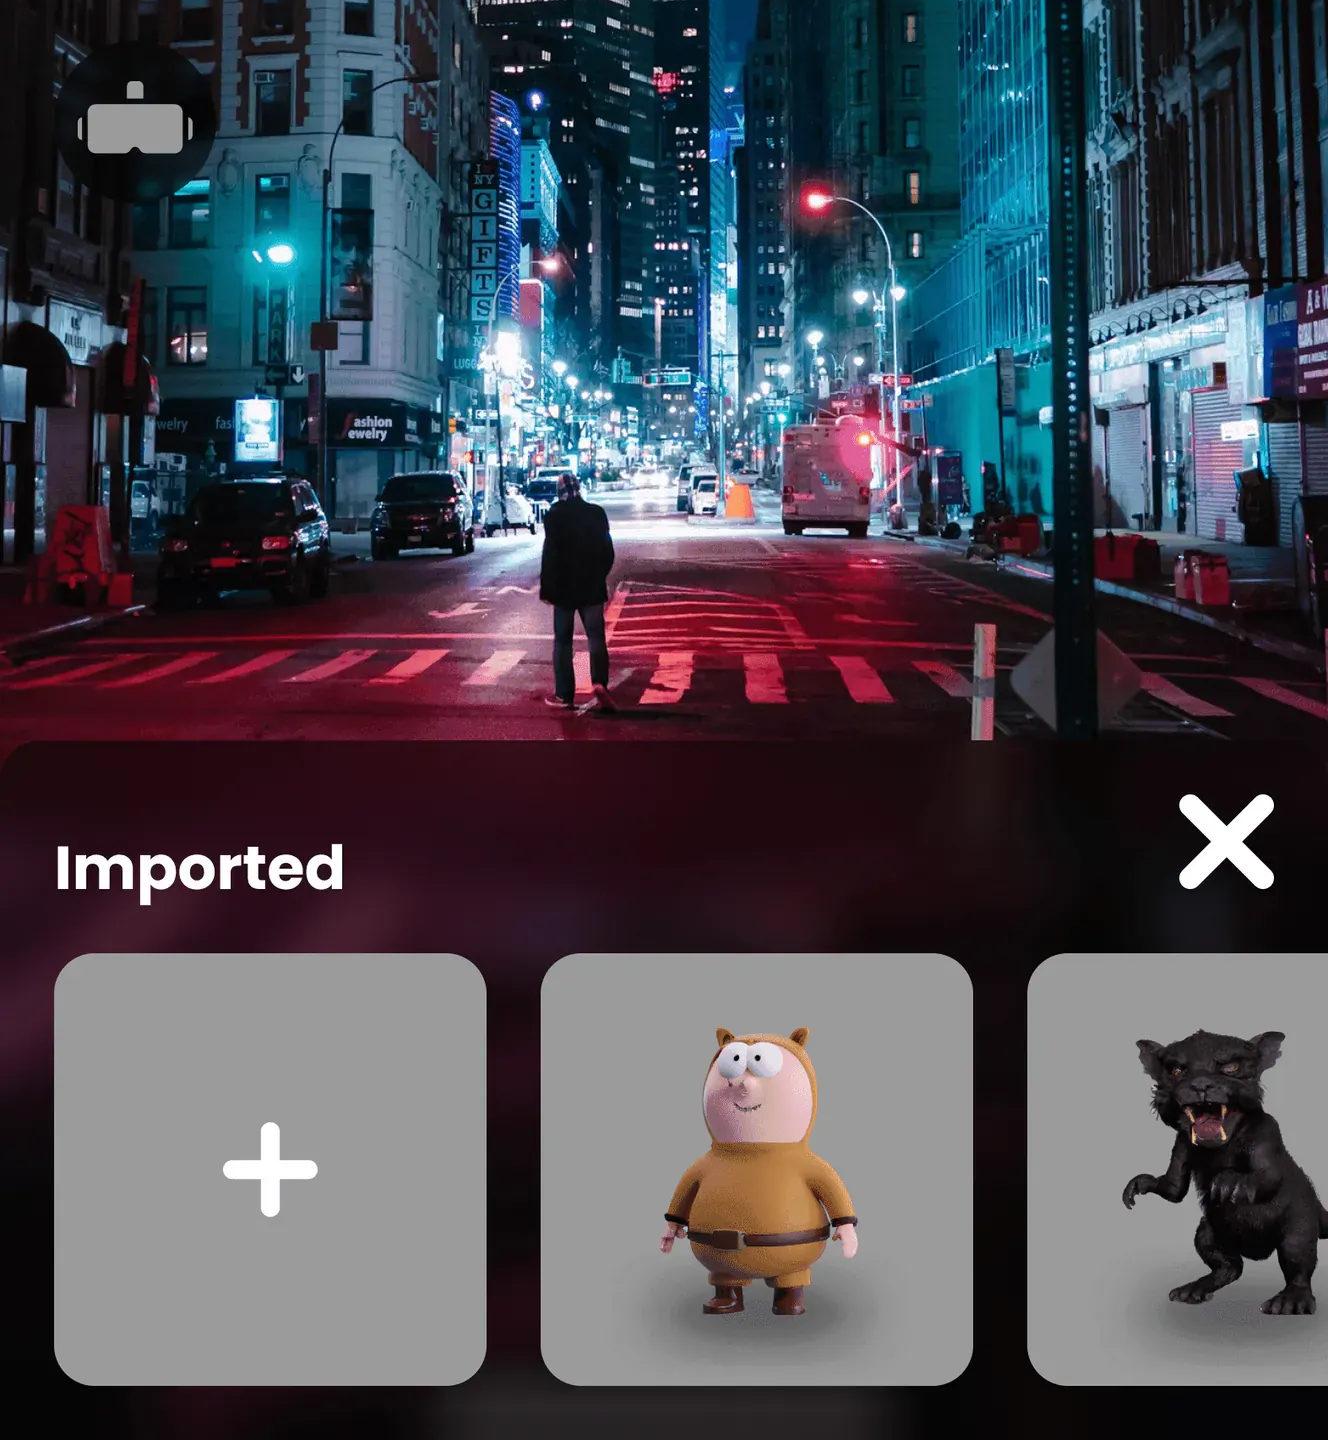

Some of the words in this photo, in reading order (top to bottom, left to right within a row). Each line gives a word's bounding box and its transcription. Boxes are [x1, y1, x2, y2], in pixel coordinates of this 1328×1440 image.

[474, 175, 495, 185] NY
[474, 192, 493, 317] GIFTS
[271, 294, 282, 361] PARK
[454, 359, 477, 370] LUGG
